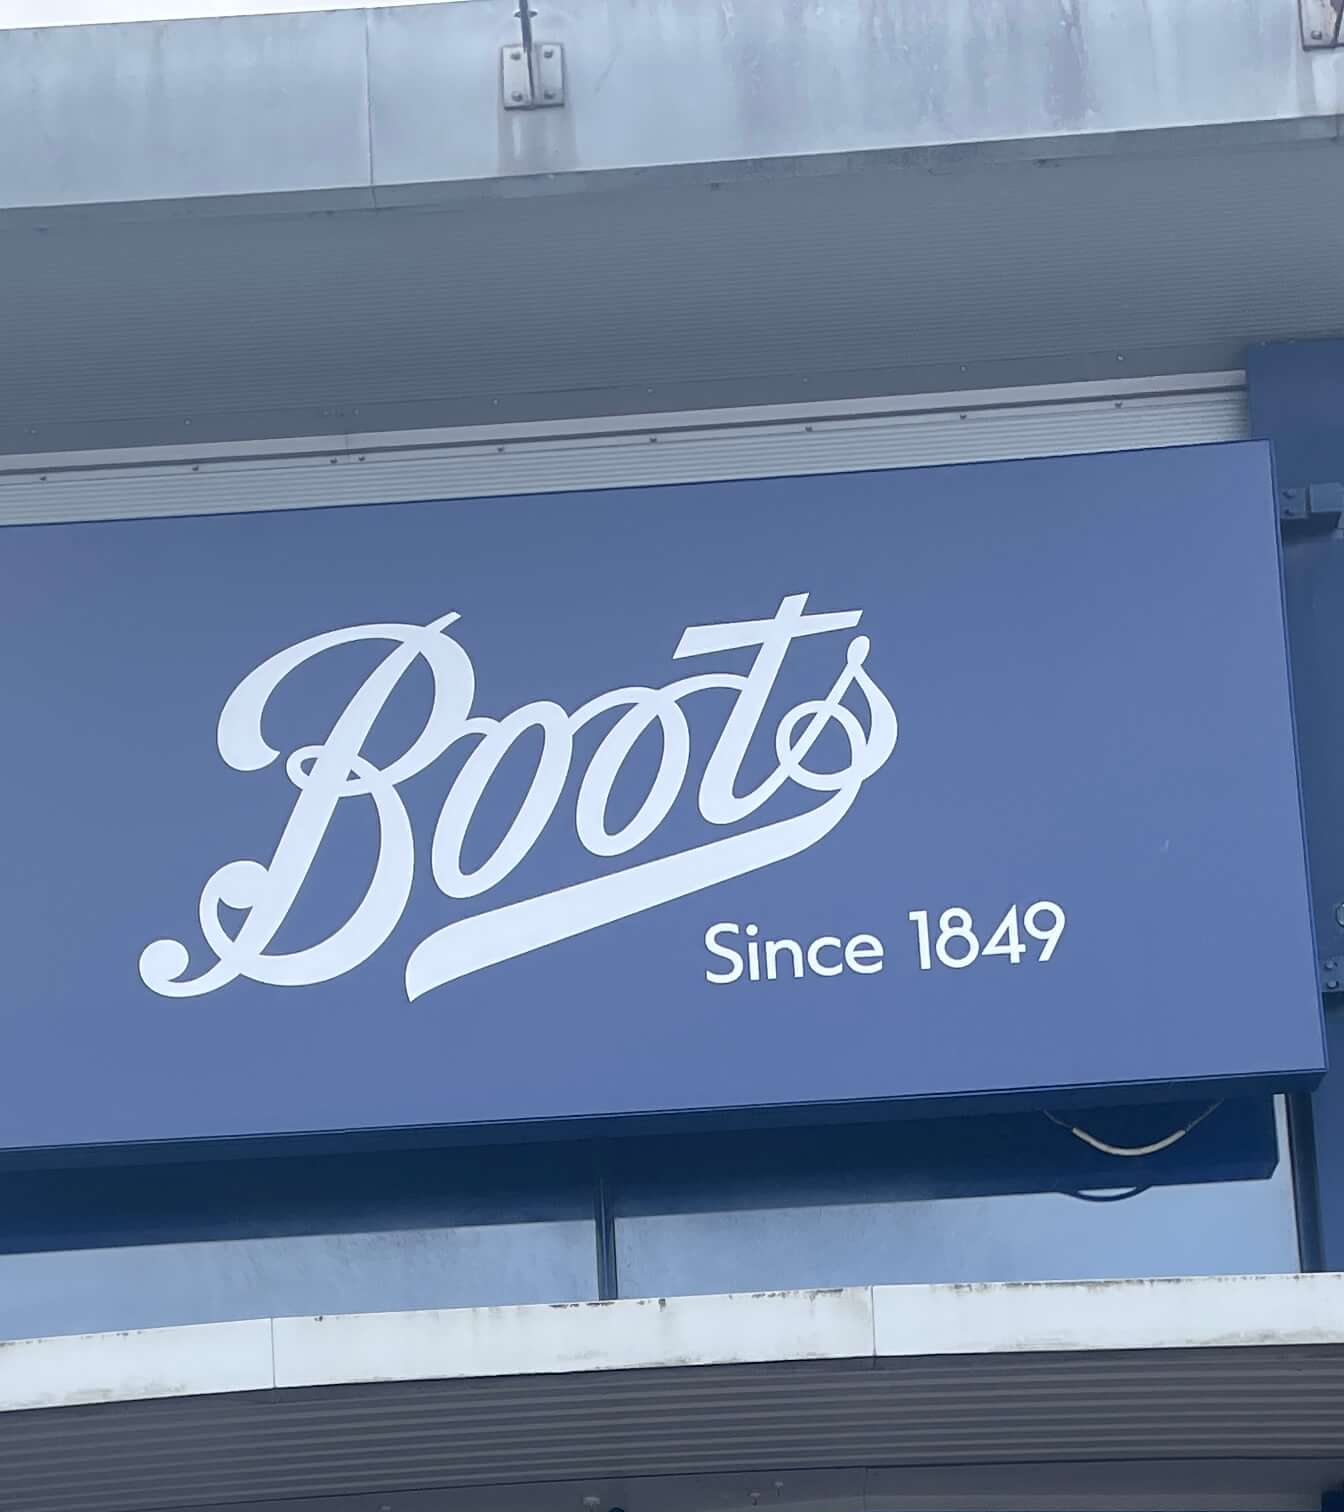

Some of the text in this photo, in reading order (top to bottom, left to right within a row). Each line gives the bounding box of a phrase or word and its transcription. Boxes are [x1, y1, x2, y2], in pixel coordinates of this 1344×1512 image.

[139, 593, 898, 1001] Boots
[705, 900, 1067, 984] Since 1849
